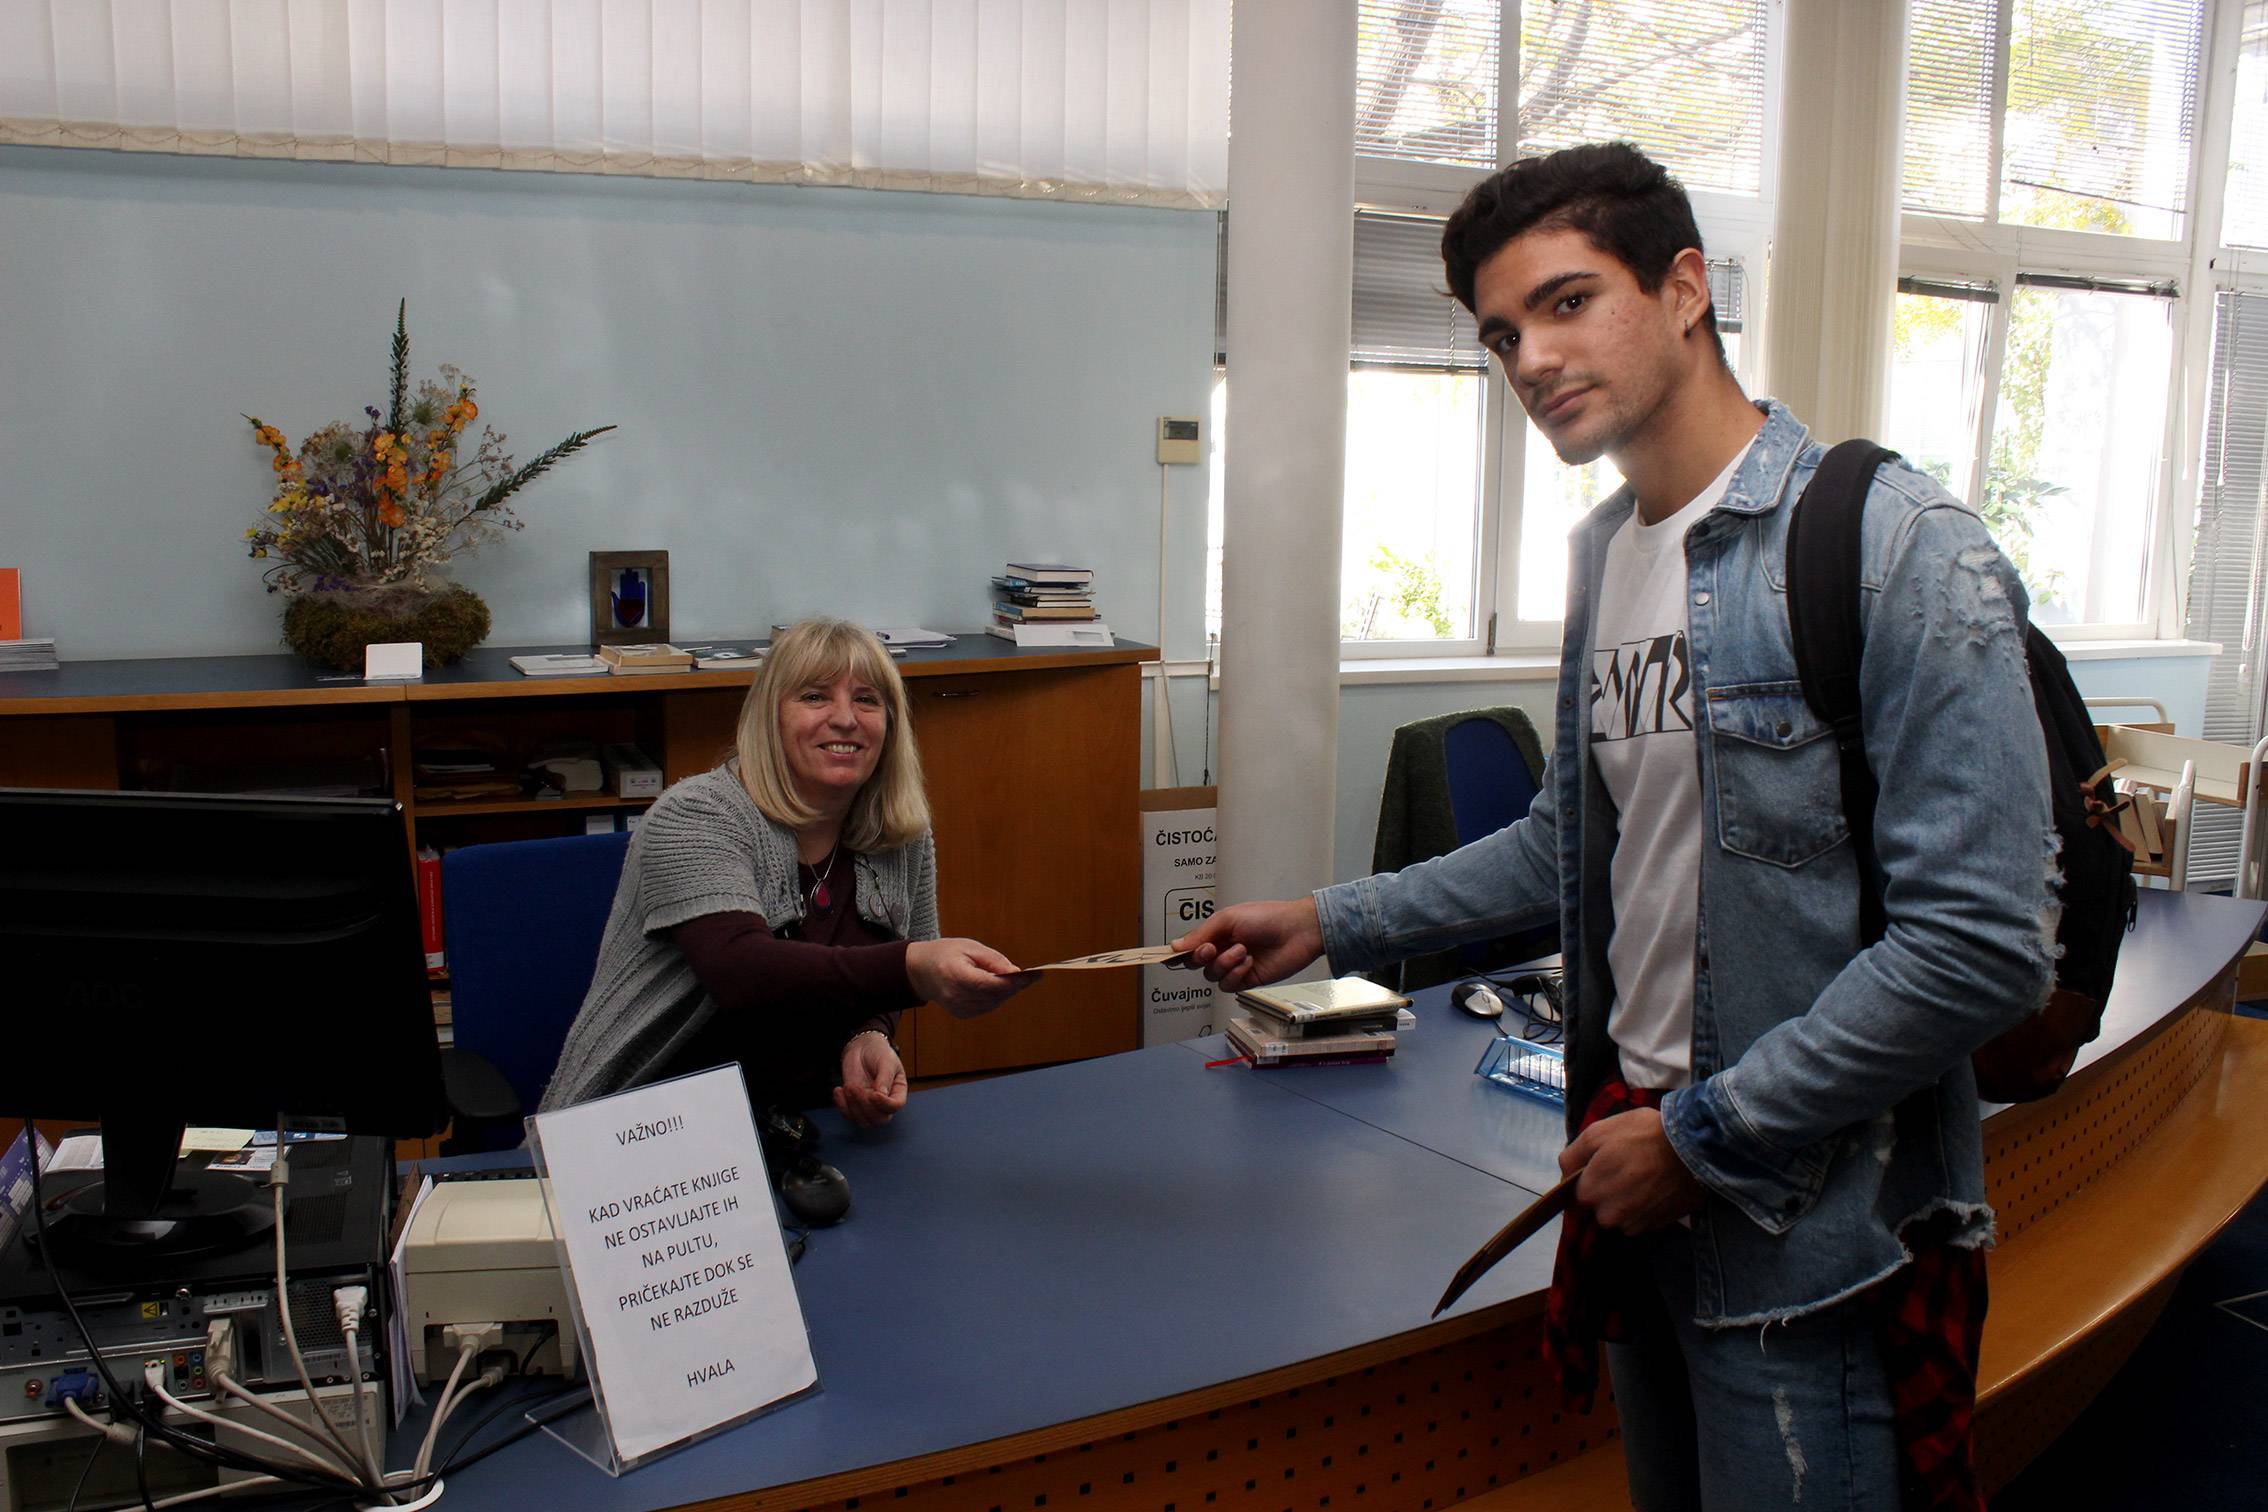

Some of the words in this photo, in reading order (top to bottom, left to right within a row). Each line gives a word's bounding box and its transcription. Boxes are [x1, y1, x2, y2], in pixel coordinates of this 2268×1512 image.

[1155, 826, 1216, 846] ČISTOĆ
[1174, 857, 1203, 867] SAMO
[1151, 987, 1212, 1002] Čuvajmo
[616, 1114, 685, 1146] VAŽNO!!!
[589, 1203, 620, 1224] KAD
[623, 1181, 690, 1213] VRAĆATE
[692, 1167, 740, 1193] KNJIGE
[605, 1231, 626, 1250] NE
[629, 1201, 721, 1242] OSTAVLJAJTE
[723, 1196, 739, 1213] IH
[642, 1249, 665, 1269] NA
[667, 1233, 718, 1261] PULTU,
[618, 1271, 702, 1312] PRIČEKAJTE
[704, 1260, 736, 1283] DOK
[738, 1254, 755, 1271] SE
[651, 1312, 671, 1332] NE
[674, 1287, 739, 1323] RAZDUŽE
[687, 1359, 736, 1388] HVALA
